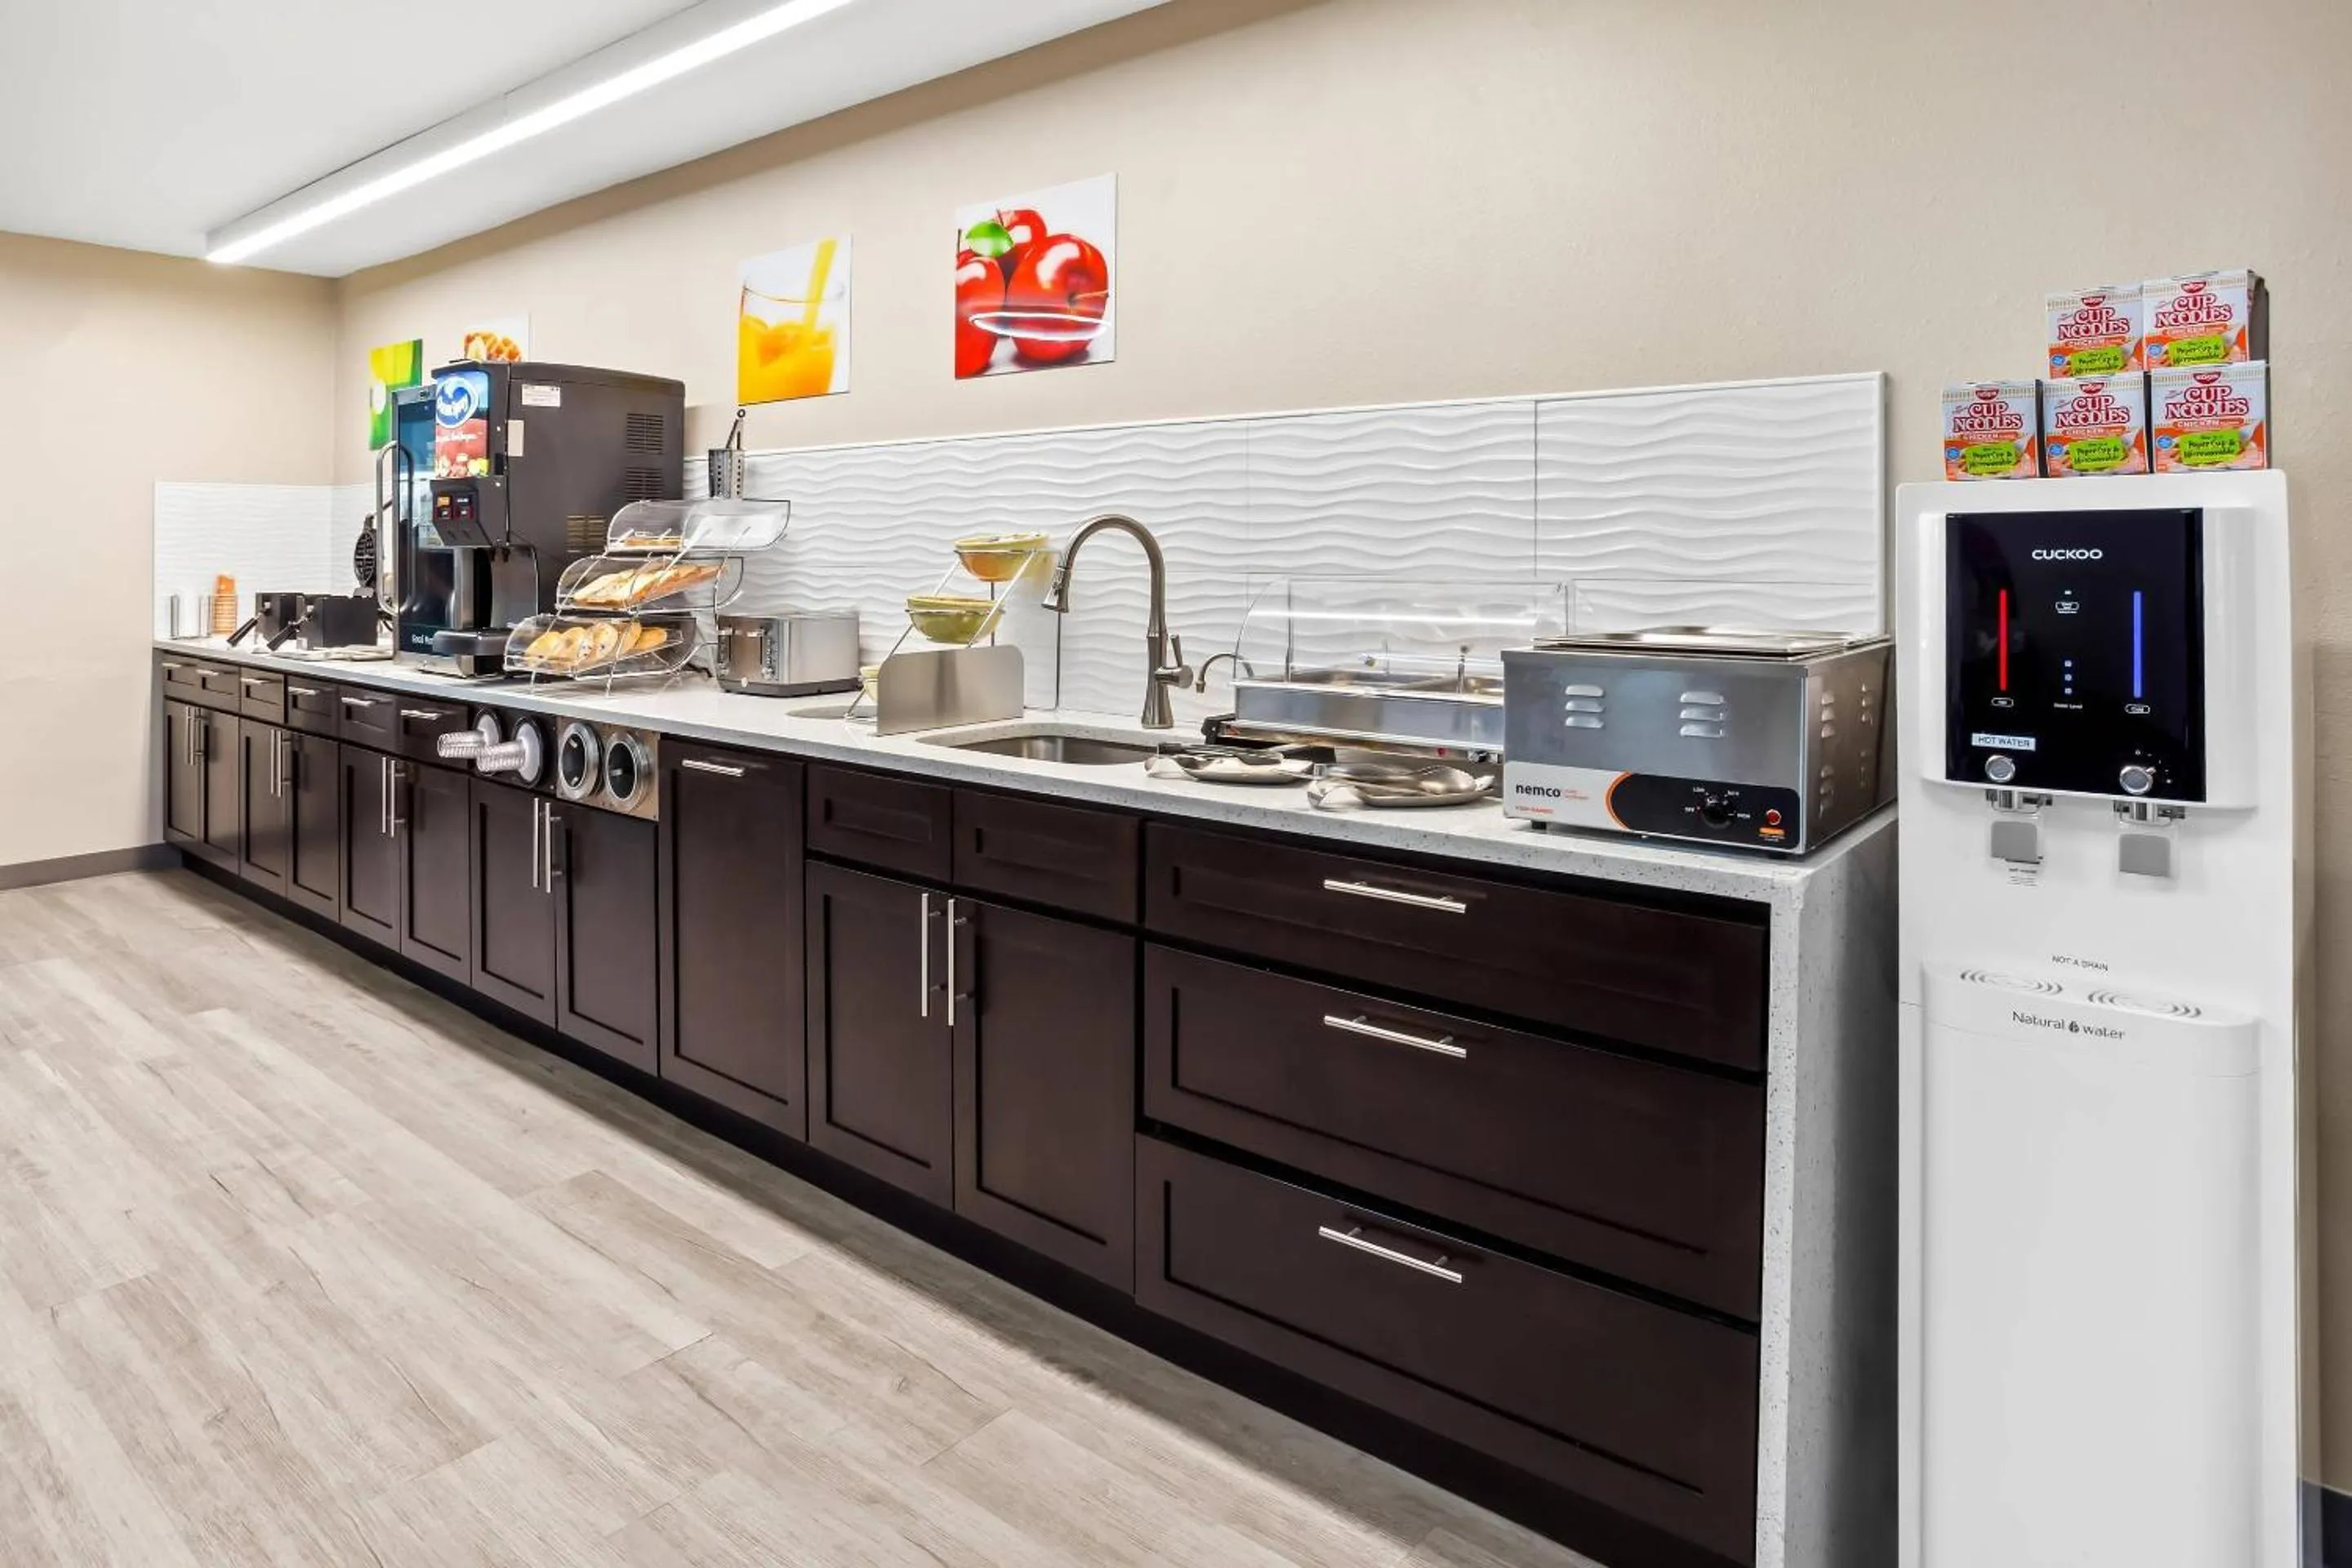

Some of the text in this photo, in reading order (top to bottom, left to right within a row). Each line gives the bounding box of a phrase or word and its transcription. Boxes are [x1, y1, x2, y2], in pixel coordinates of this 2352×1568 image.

[2173, 293, 2216, 311] CUP
[2074, 307, 2115, 324] CUP
[2155, 304, 2233, 328] NOODLES
[2057, 318, 2130, 341] NOODLES
[2071, 394, 2114, 412] CUP
[2184, 385, 2232, 403] CUP
[1968, 401, 2009, 418] CUP
[2056, 407, 2130, 428] NOODLES
[2165, 398, 2249, 419] NOODLES
[1953, 413, 2023, 433] NOODLES
[2032, 549, 2103, 560] CUCKOO
[1978, 735, 2030, 747] HOT WATER
[1516, 784, 1561, 797] nemco
[2052, 955, 2070, 964] NOT
[2082, 960, 2109, 971] DRAIN
[2012, 1011, 2125, 1039] Natural water
